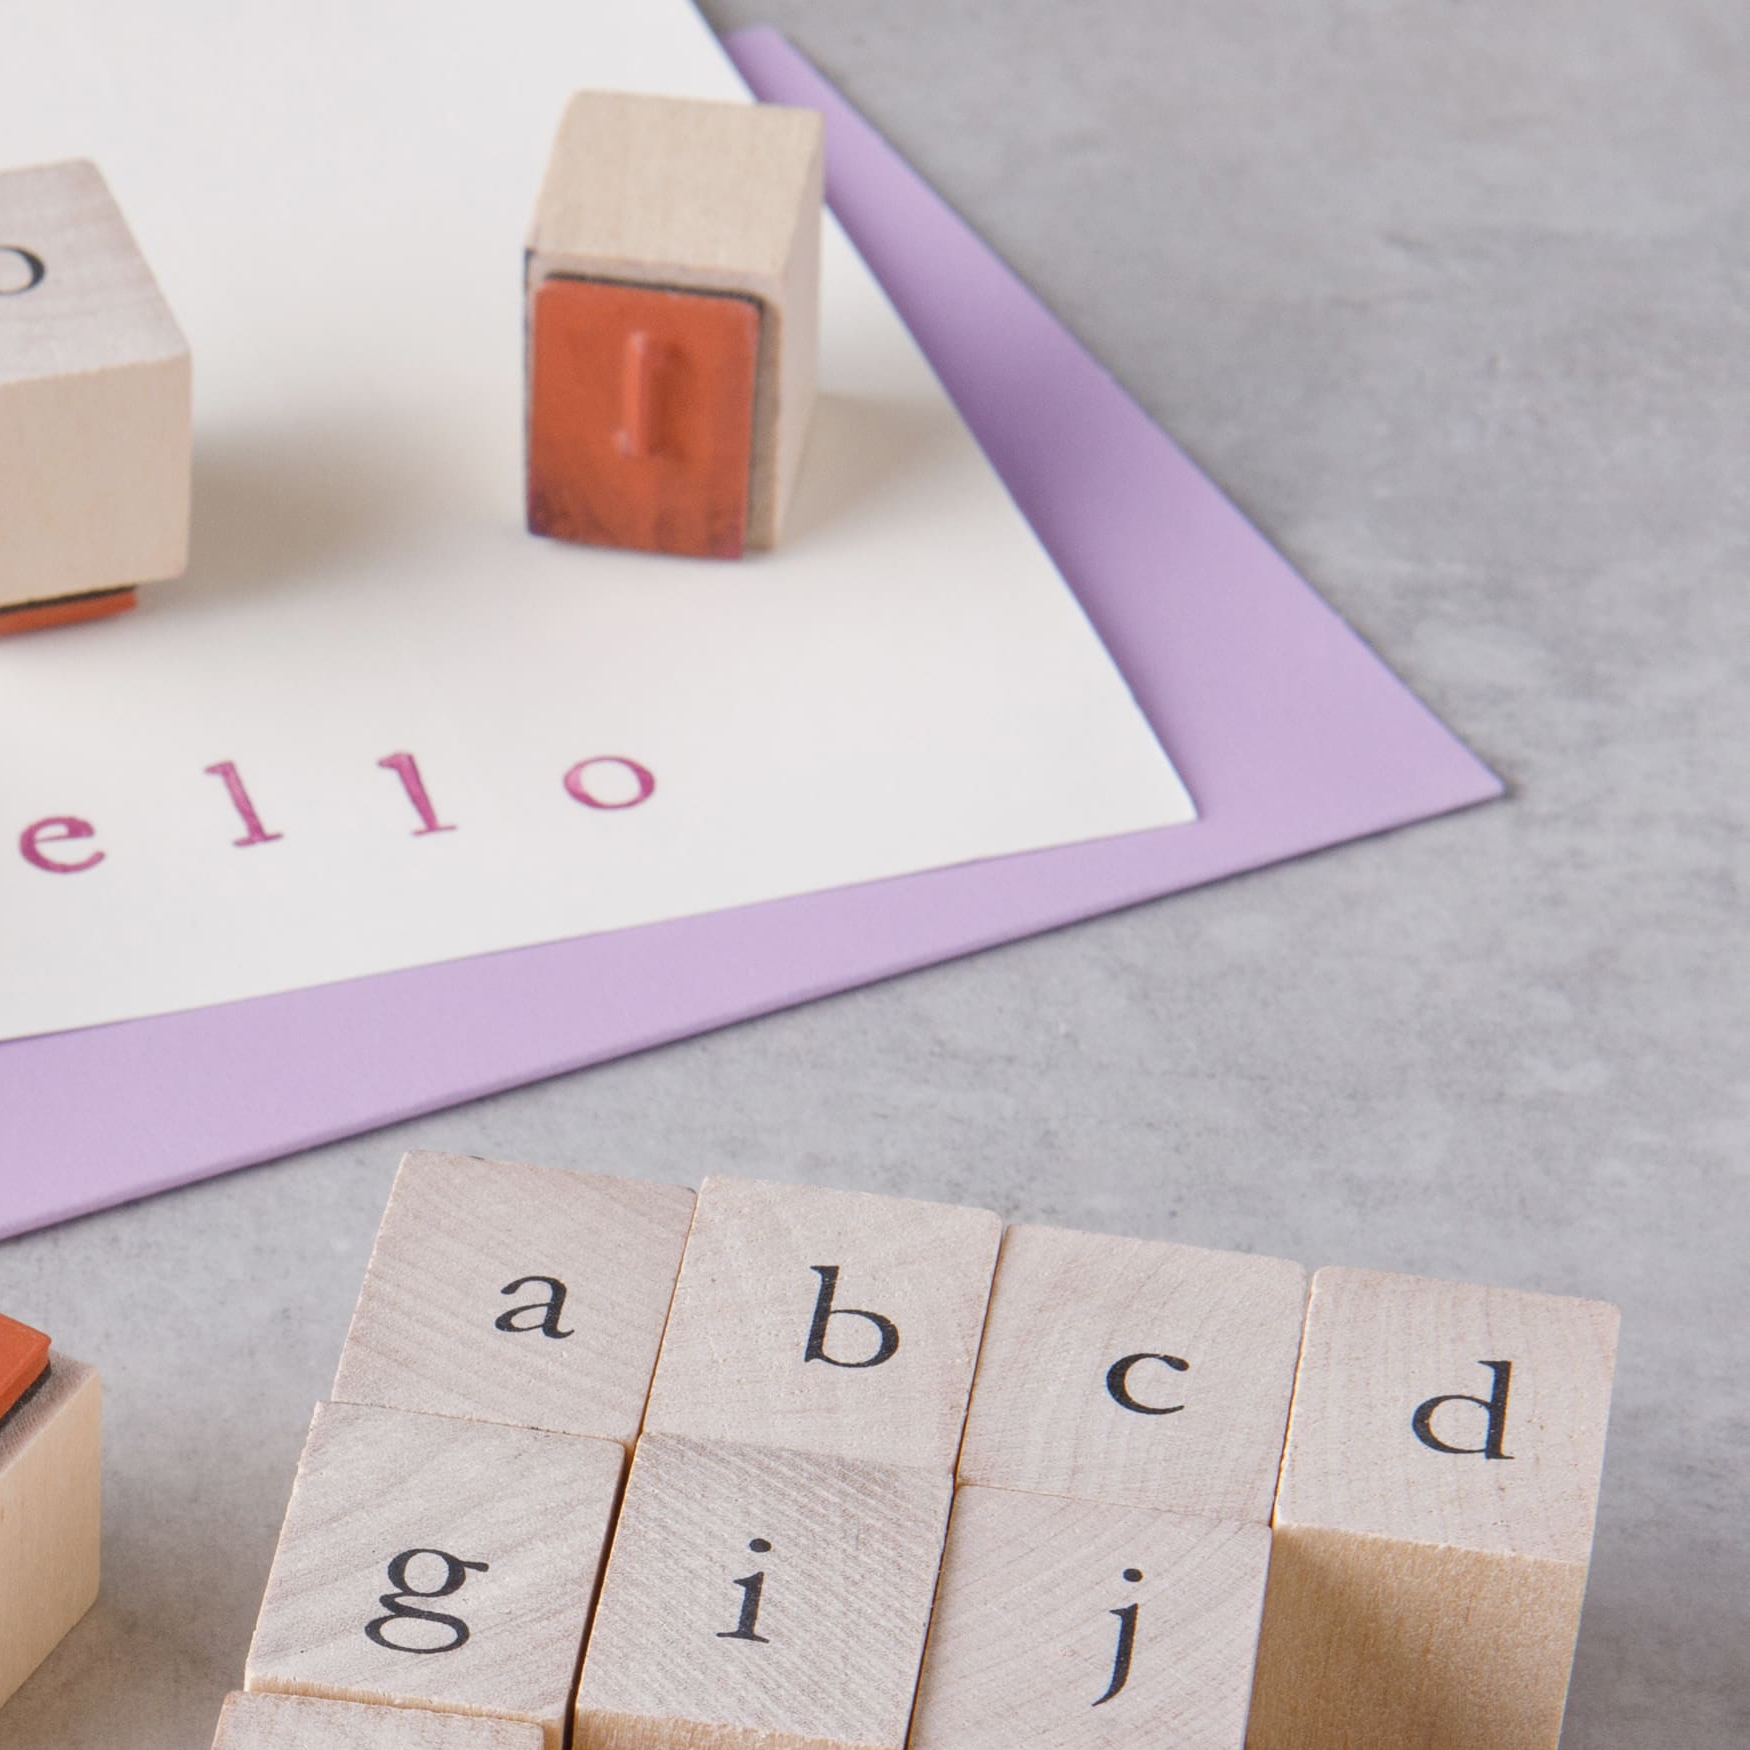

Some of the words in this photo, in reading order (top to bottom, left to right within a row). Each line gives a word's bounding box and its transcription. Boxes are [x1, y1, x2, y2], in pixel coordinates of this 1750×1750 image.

[495, 1276, 574, 1339] a
[805, 1266, 899, 1368] b
[1106, 1353, 1189, 1415] c
[1412, 1361, 1513, 1459] d
[365, 1549, 489, 1654] g
[717, 1538, 771, 1643] i
[1093, 1569, 1142, 1706] j
